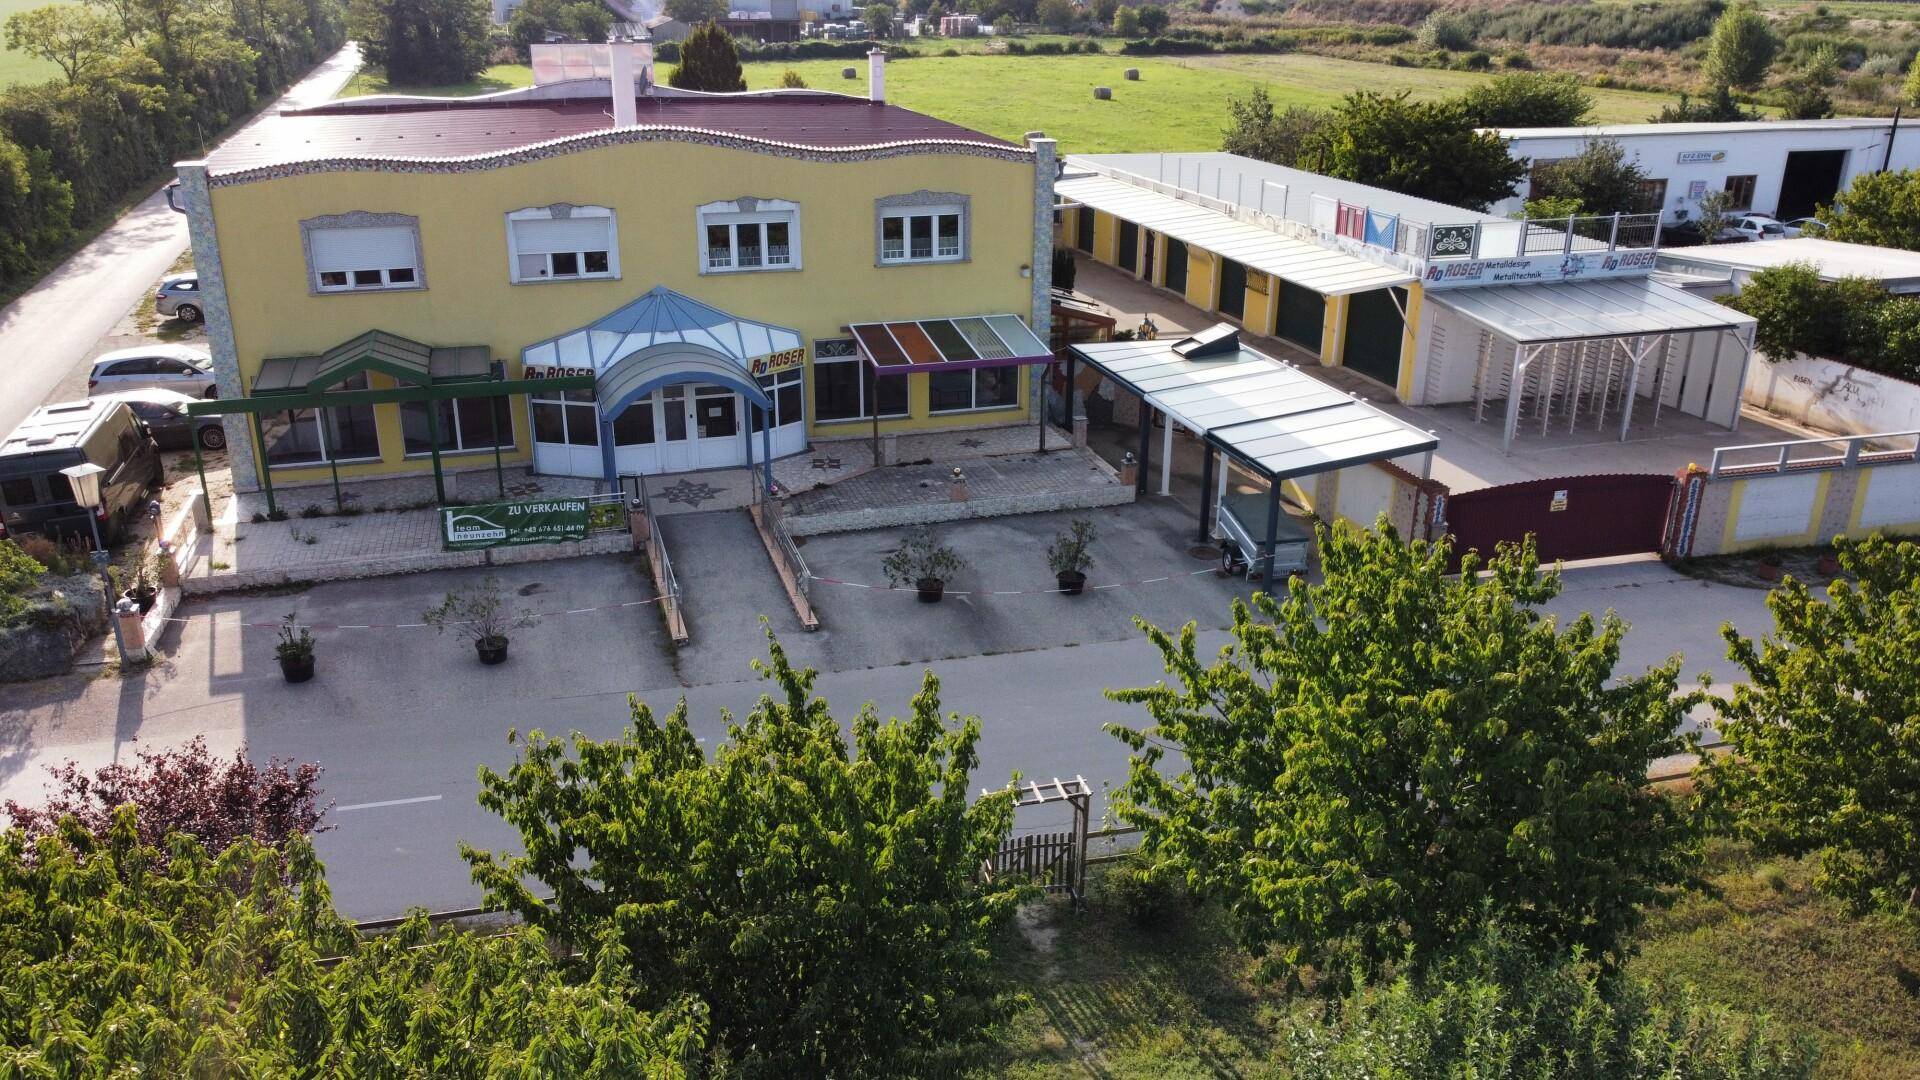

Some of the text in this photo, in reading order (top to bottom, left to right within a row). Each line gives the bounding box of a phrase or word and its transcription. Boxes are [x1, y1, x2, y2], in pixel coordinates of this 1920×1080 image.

[1485, 259, 1531, 269] Metalldesign
[1619, 252, 1656, 267] ROSER
[1444, 262, 1485, 277] ROSER
[1493, 271, 1543, 281] Metalltechnik
[768, 348, 805, 369] ROSER
[507, 501, 585, 516] ZU VERKAUFEN
[457, 531, 504, 540] neunzehn
